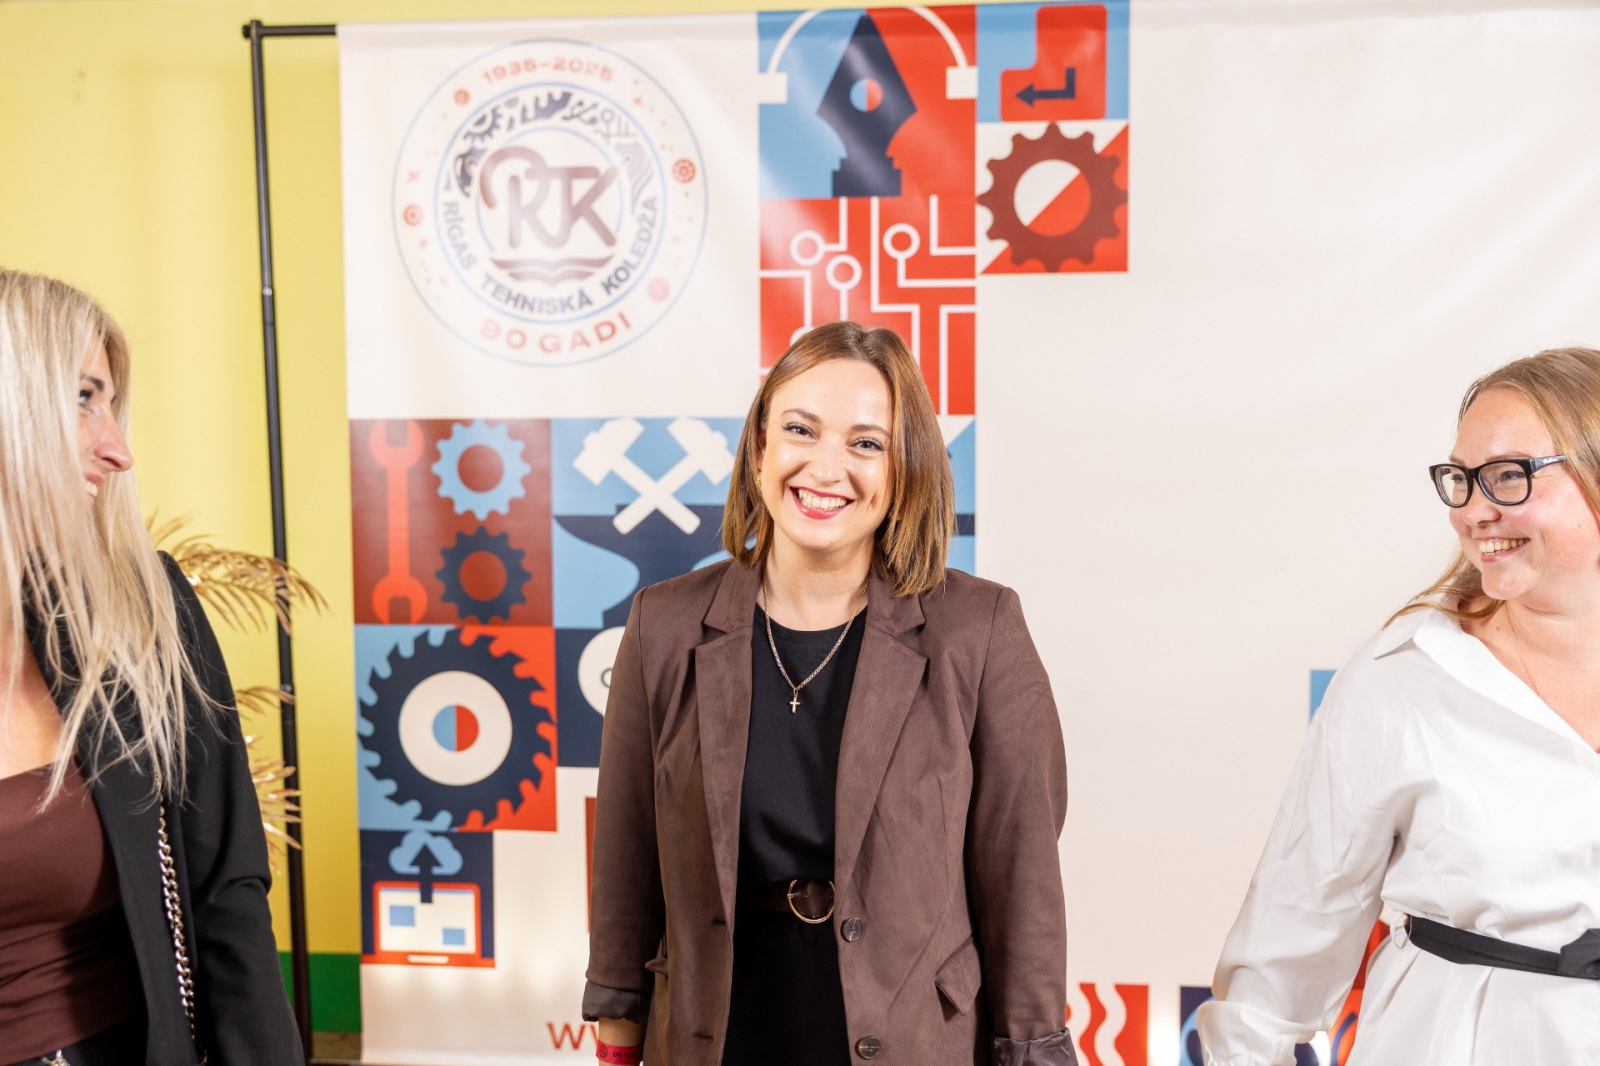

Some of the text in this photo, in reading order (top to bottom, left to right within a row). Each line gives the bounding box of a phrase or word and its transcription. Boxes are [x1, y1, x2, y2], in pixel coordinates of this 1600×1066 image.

[443, 196, 658, 314] RĪGAS TEHNISKĀ KOLEDŽA
[480, 311, 631, 353] 90 GADI
[547, 1022, 599, 1050] W
